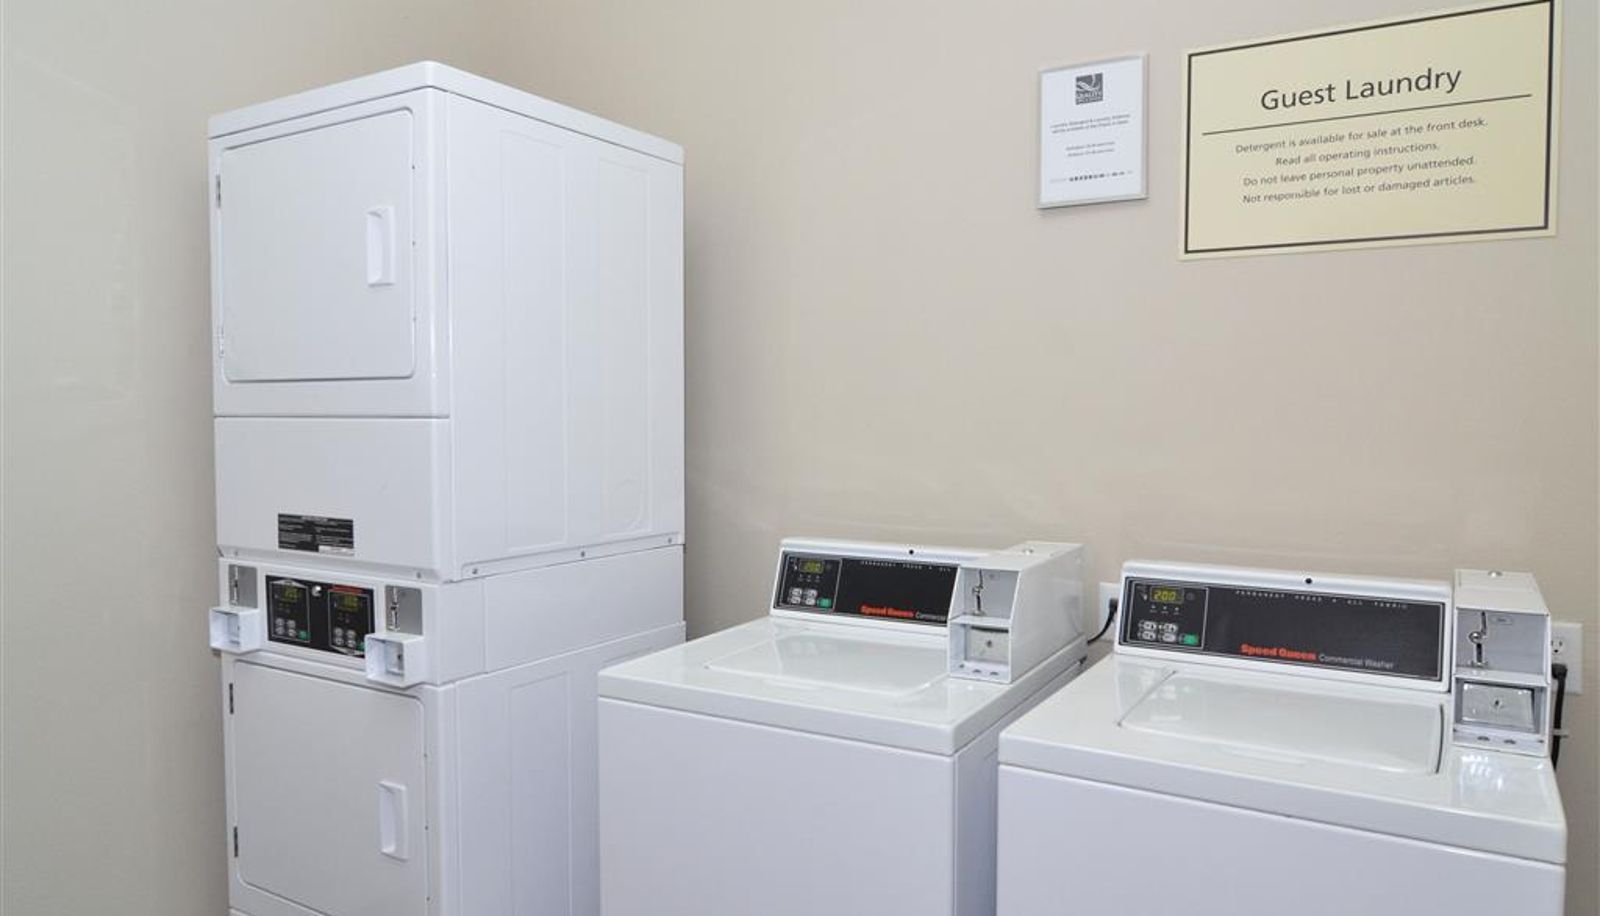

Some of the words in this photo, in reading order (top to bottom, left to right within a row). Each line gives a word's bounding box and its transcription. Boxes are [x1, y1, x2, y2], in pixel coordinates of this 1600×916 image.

[1261, 83, 1336, 111] Guest
[1346, 67, 1462, 99] Laundry
[1235, 140, 1286, 153] Detergent
[1288, 139, 1297, 147] is
[1299, 132, 1345, 147] available
[1348, 130, 1364, 140] for
[1367, 128, 1388, 139] sale
[1390, 126, 1402, 137] at
[1405, 123, 1424, 134] the
[1426, 121, 1456, 133] front
[1458, 117, 1489, 129] desk.
[1275, 156, 1301, 166] Read
[1303, 154, 1317, 163] all
[1318, 149, 1371, 163] operating
[1243, 177, 1259, 187] Do
[1260, 174, 1278, 185] not
[1281, 172, 1307, 183] leave
[1309, 167, 1355, 182] personal
[1356, 161, 1404, 177] property
[1243, 193, 1262, 203] Not
[1263, 188, 1320, 202] responsible
[1323, 186, 1339, 197] for
[1342, 183, 1361, 195] lost
[1363, 184, 1376, 193] or
[1377, 178, 1431, 192] damaged
[1240, 643, 1278, 656] Speed
[1278, 647, 1317, 661] Queen
[1318, 653, 1364, 667] Commercial
[1364, 658, 1395, 671] Washer
